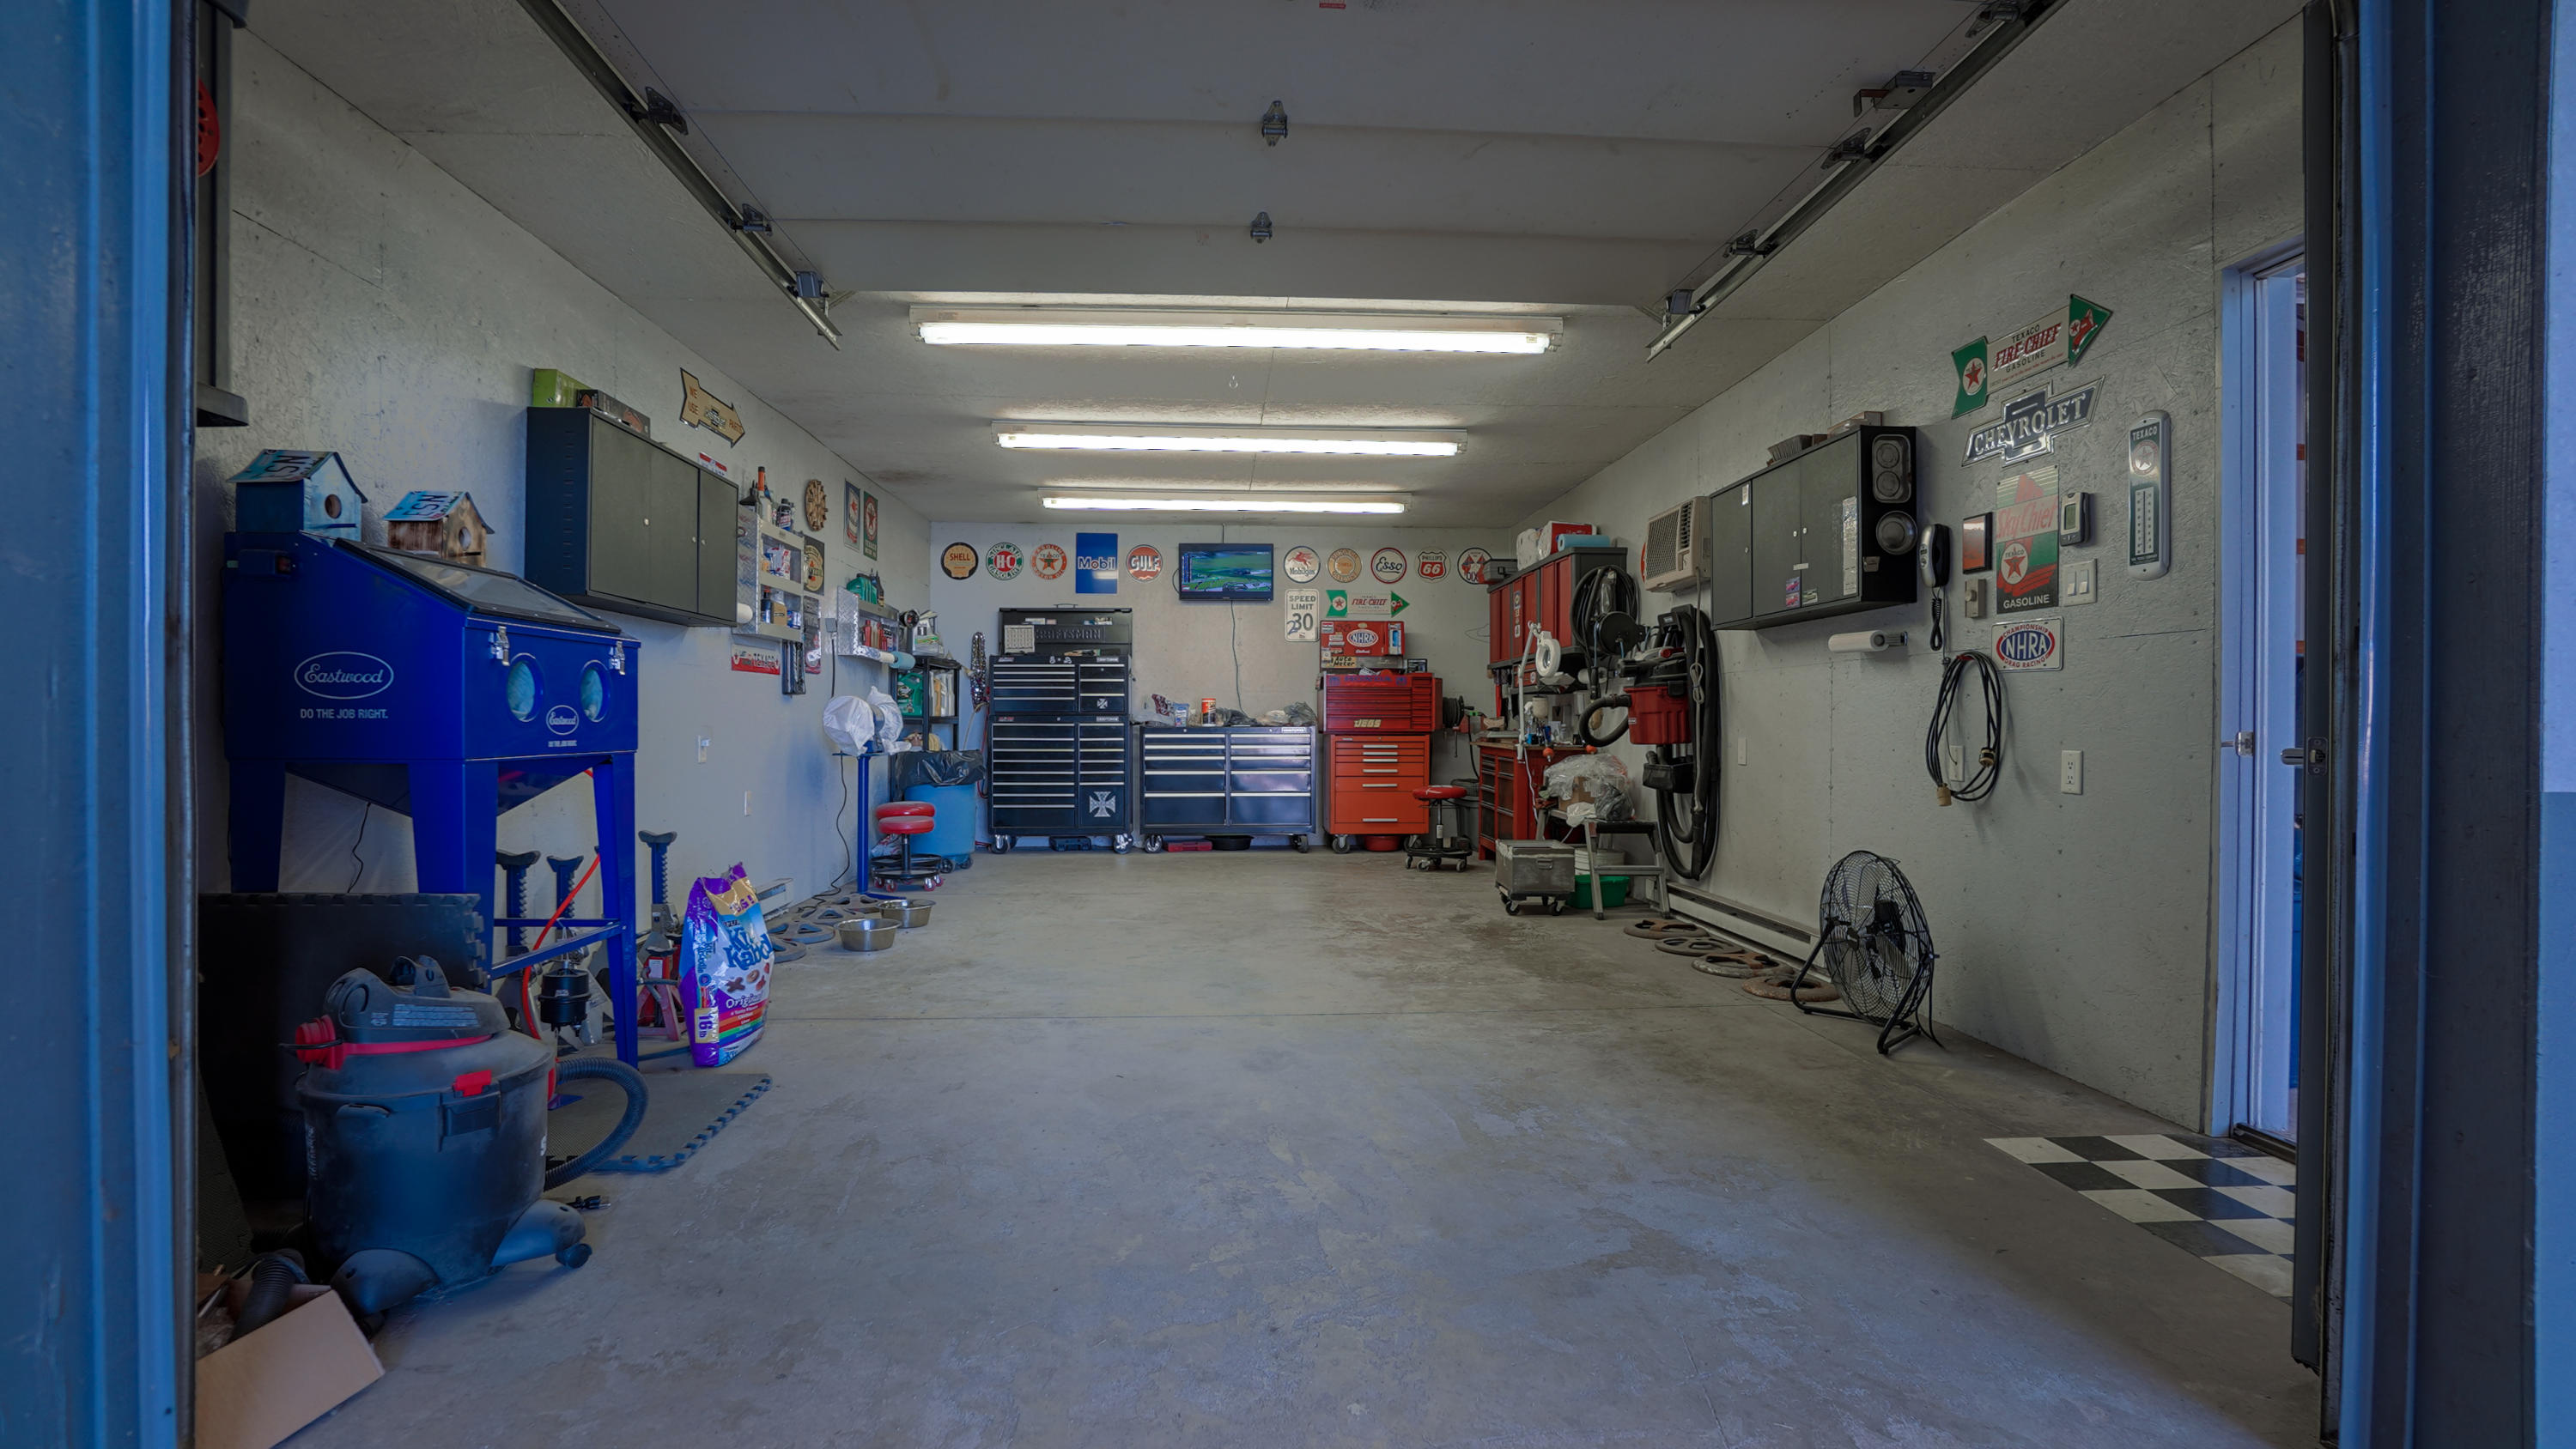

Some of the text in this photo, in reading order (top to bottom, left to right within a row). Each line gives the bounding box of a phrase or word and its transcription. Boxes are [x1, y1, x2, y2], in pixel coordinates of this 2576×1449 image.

[2012, 324, 2040, 343] TEXACO
[1992, 323, 2062, 371] FIRE-CHIEF
[2005, 349, 2046, 373] GASOLINE
[1974, 392, 2087, 456] CHEVROLET
[2132, 426, 2157, 441] TEXACO
[1996, 495, 2057, 539] Sky Chief
[950, 553, 970, 561] SHELL
[1078, 556, 1116, 570] Mobil
[1131, 555, 1160, 572] GULF
[1376, 556, 1403, 573] Esso
[1290, 567, 1316, 577] Mobilgas
[1423, 563, 1442, 574] 66
[1466, 572, 1479, 582] DIX
[2003, 594, 2050, 609] GASOLINE
[1292, 612, 1314, 631] 30
[1352, 633, 1374, 644] NHRA
[2002, 624, 2049, 638] CHAMPIONSHIP
[2006, 632, 2048, 659] NHRA
[2004, 654, 2050, 668] DRAG RACING
[304, 663, 385, 683] Eastwood
[301, 708, 389, 719] DO THE JOB RIGHT.
[698, 1015, 714, 1029] 16
